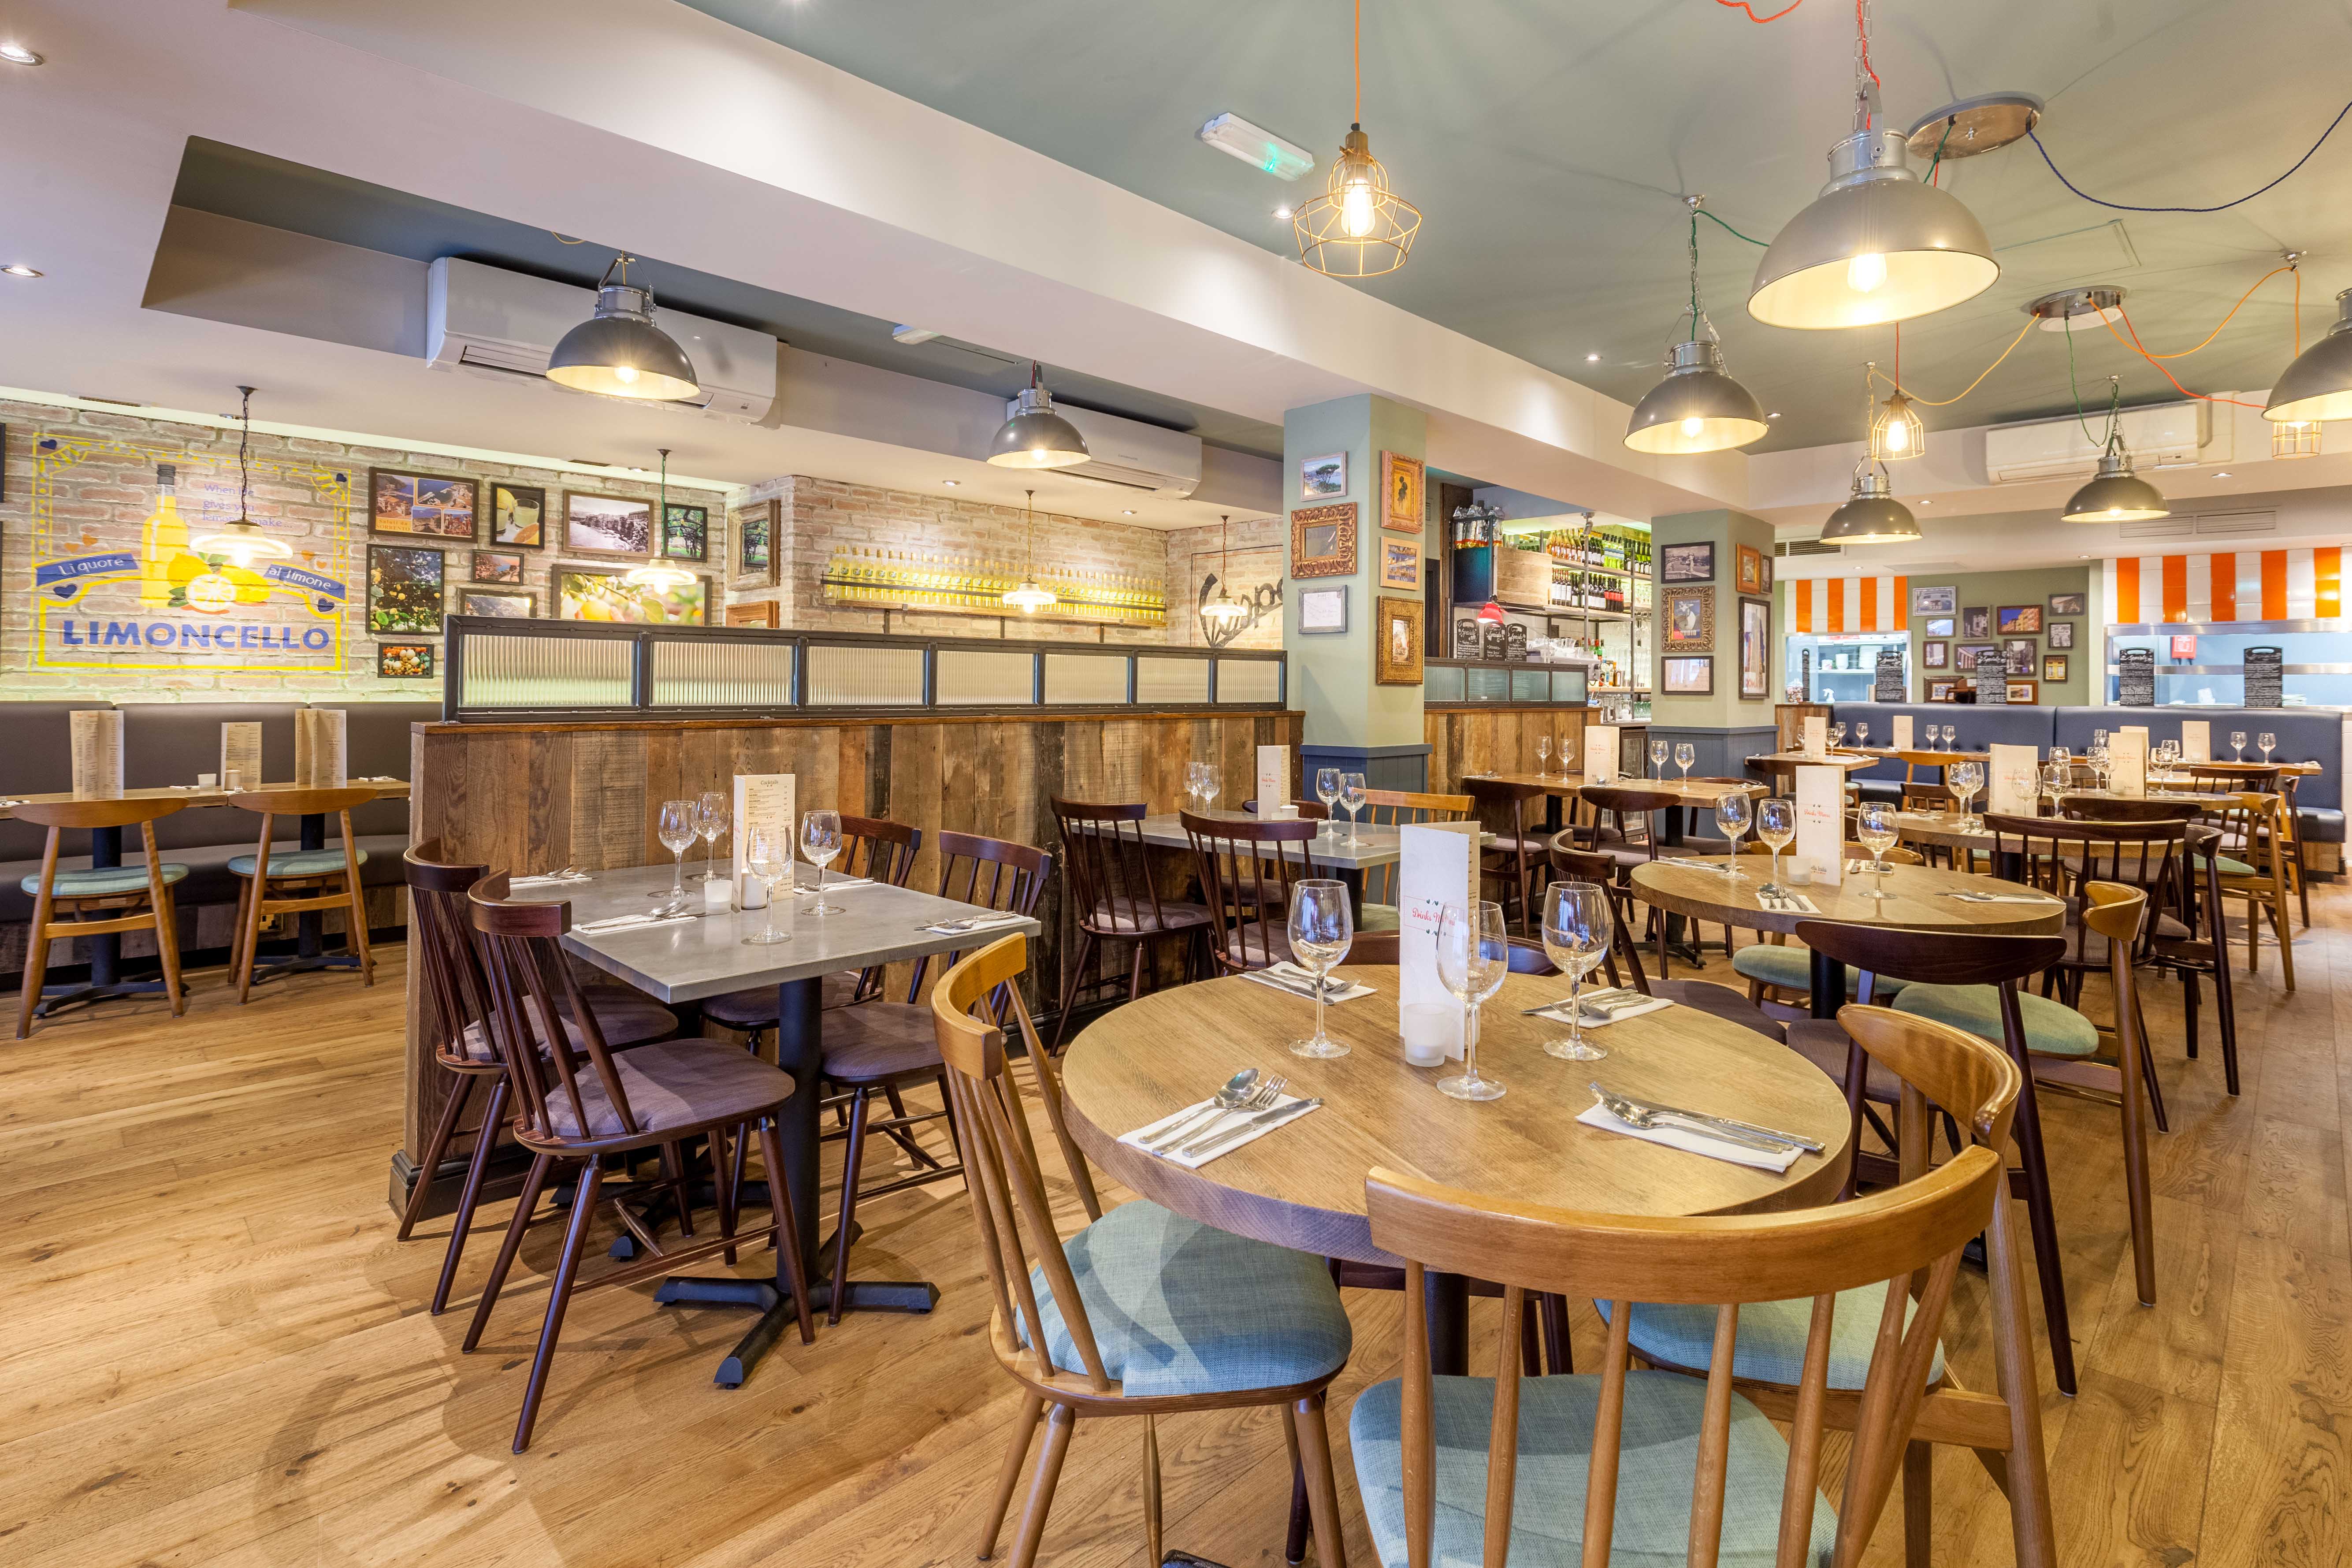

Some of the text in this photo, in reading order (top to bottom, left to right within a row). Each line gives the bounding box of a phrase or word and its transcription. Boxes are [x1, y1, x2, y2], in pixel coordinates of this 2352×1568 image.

[204, 483, 235, 495] When
[203, 500, 231, 510] gives
[202, 512, 241, 522] lemon
[58, 558, 124, 576] Liquore
[268, 567, 331, 590] al limone
[63, 620, 329, 651] LIMONCELLO
[1412, 907, 1431, 921] Drinks
